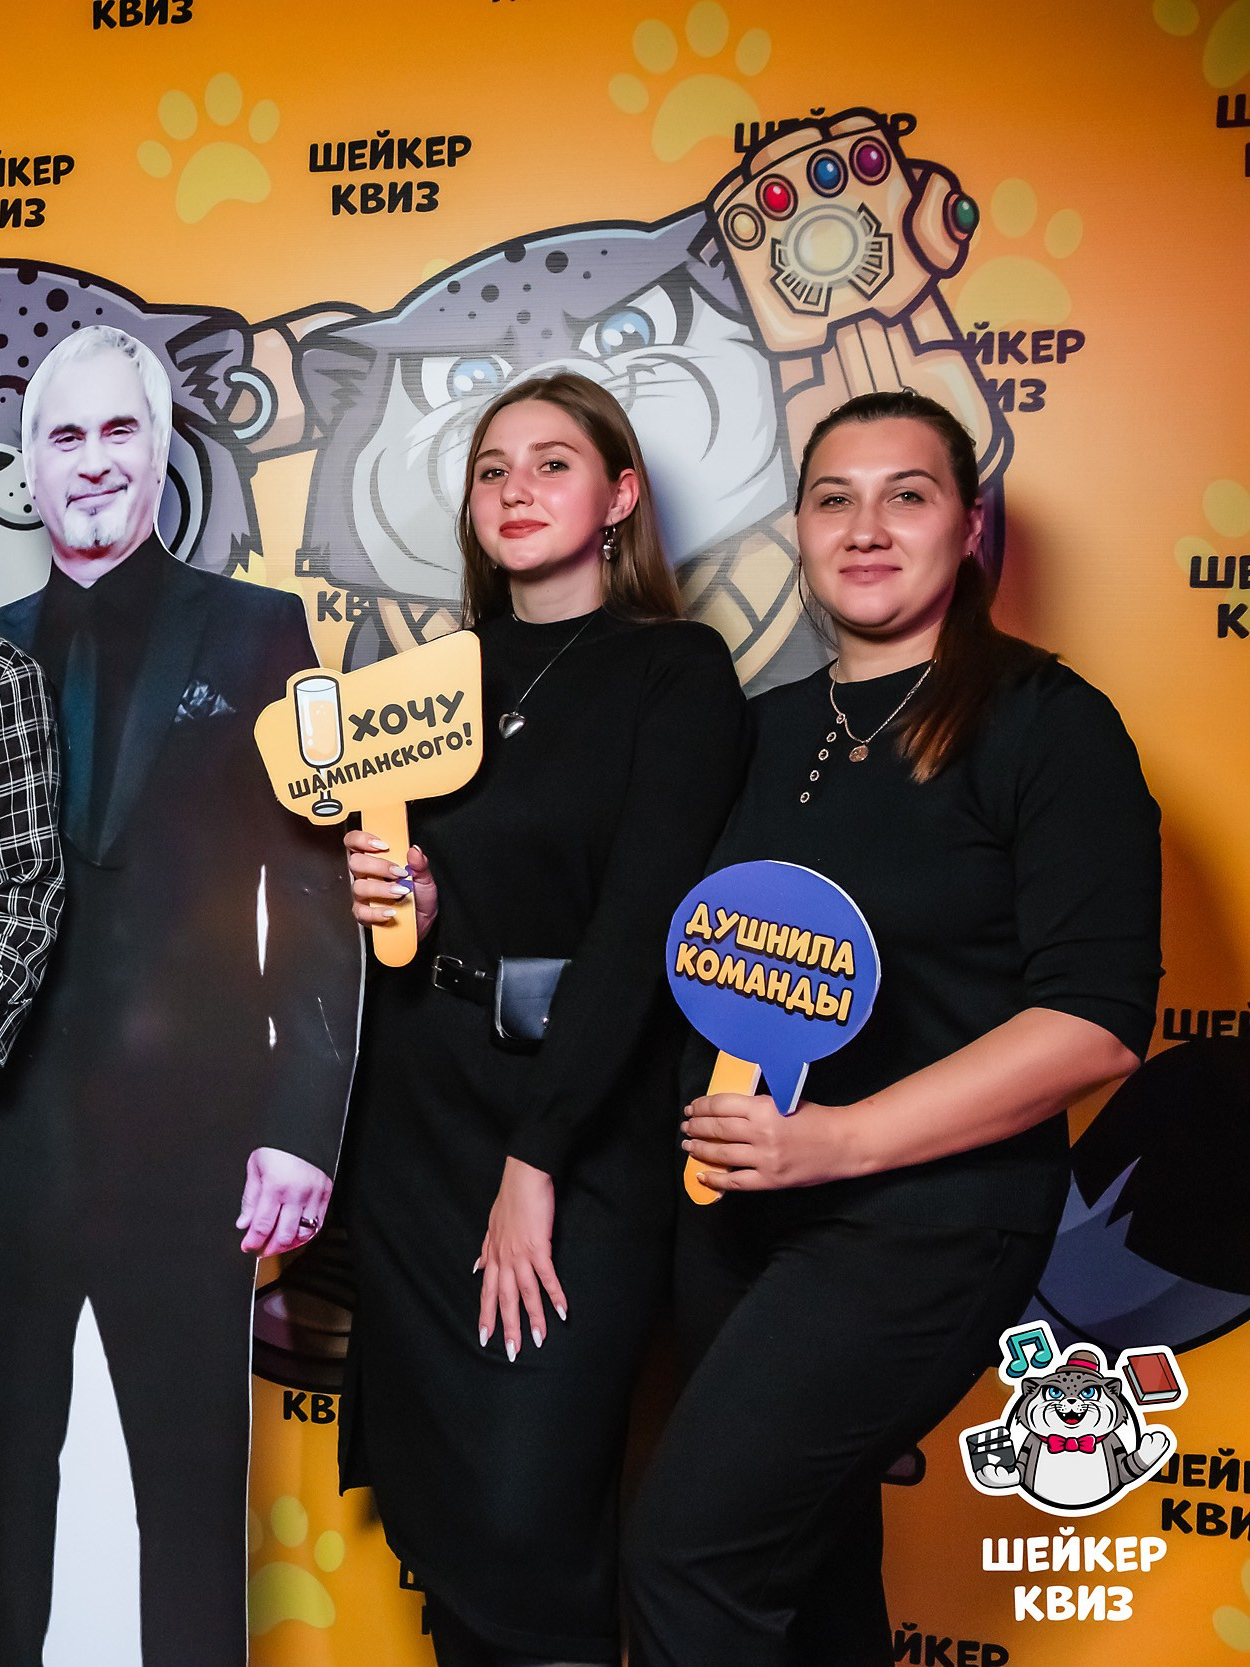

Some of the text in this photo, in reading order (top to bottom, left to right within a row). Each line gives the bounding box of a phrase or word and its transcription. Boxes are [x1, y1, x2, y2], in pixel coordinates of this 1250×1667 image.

[93, 0, 193, 30] КВИЗ
[309, 129, 472, 173] ШЕЙКЕР
[332, 181, 440, 216] КВИЗ
[963, 321, 1086, 365] ЙКЕР
[986, 378, 1047, 412] ИЗ
[317, 590, 371, 622] КВ
[348, 690, 465, 742] ХОЧУ
[288, 722, 473, 800] ШАМПАНСКОГО!
[685, 901, 856, 979] ДУШНИЛА
[675, 941, 854, 1026] КОМАНДЫ
[283, 1390, 336, 1424] КВ
[1161, 1498, 1250, 1541] КВИ
[894, 1622, 1009, 1667] ЙКЕР
